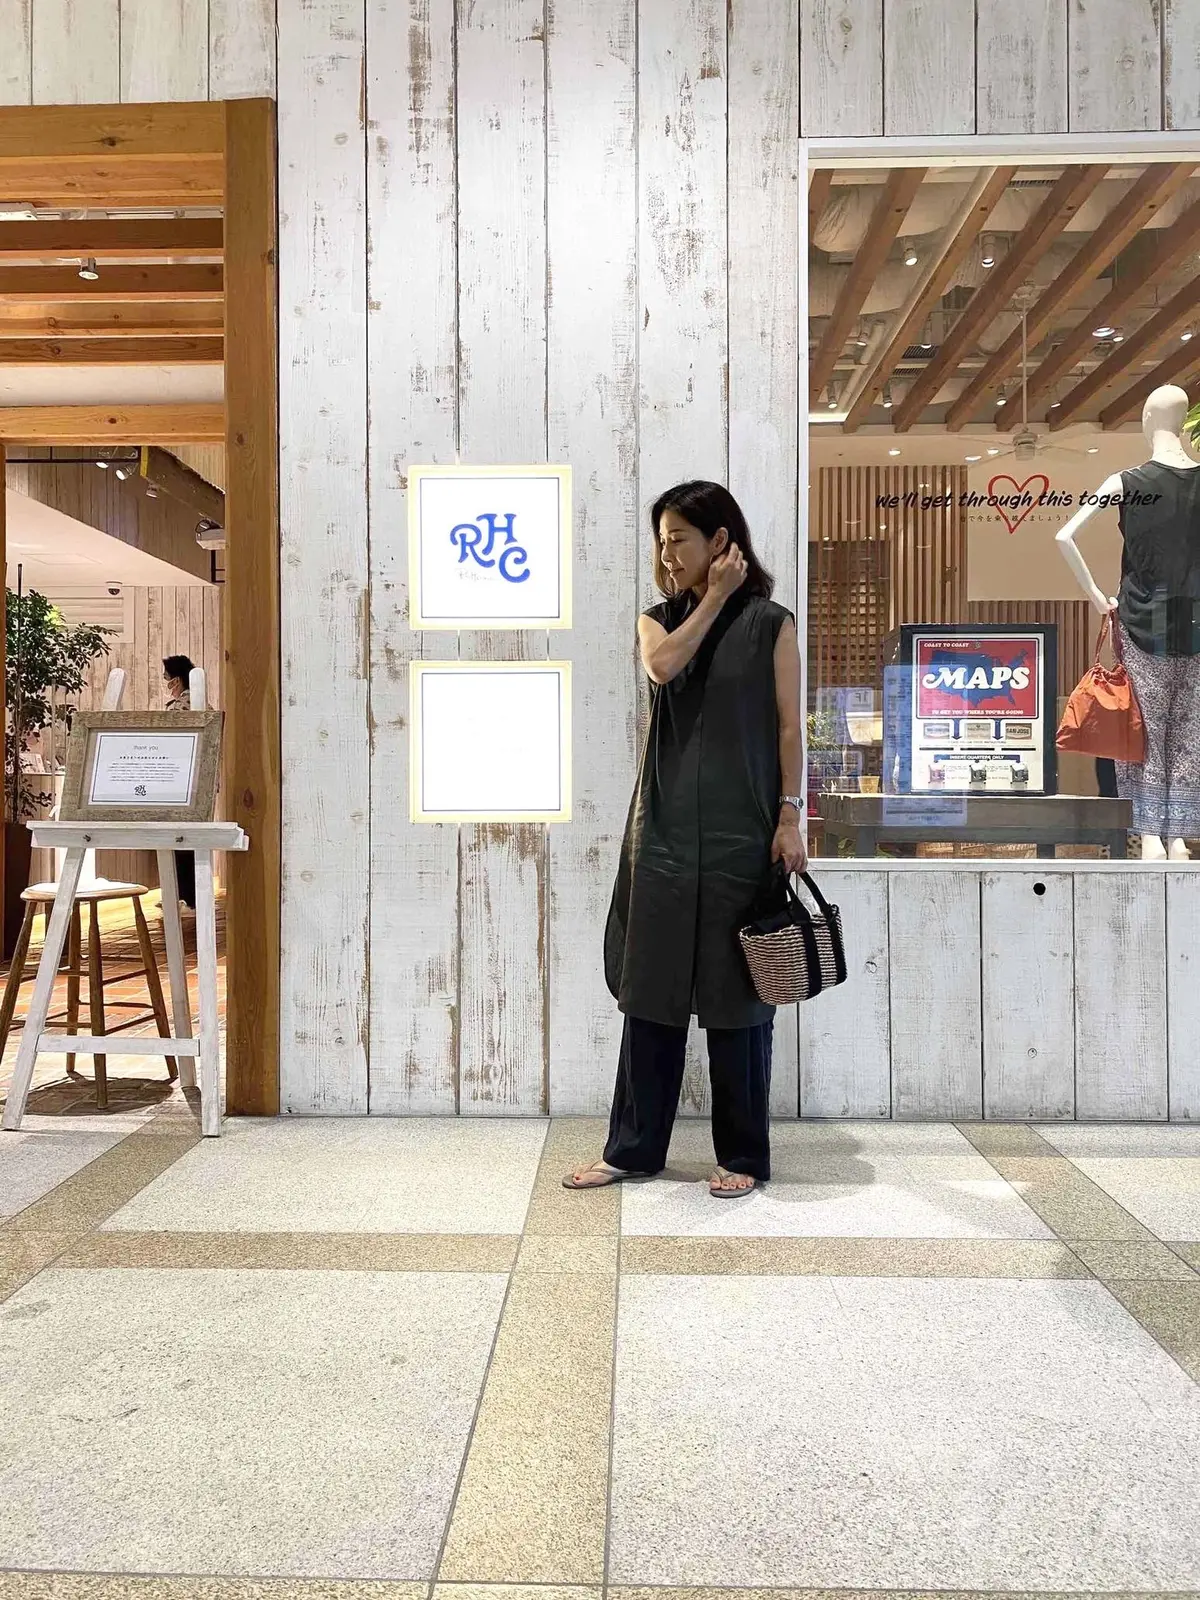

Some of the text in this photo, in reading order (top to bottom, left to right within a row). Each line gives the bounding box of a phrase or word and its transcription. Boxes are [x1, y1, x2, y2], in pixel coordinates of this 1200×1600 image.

[875, 490, 1162, 511] we'll get through this together
[450, 513, 530, 583] RHC
[922, 667, 1030, 689] MAPS
